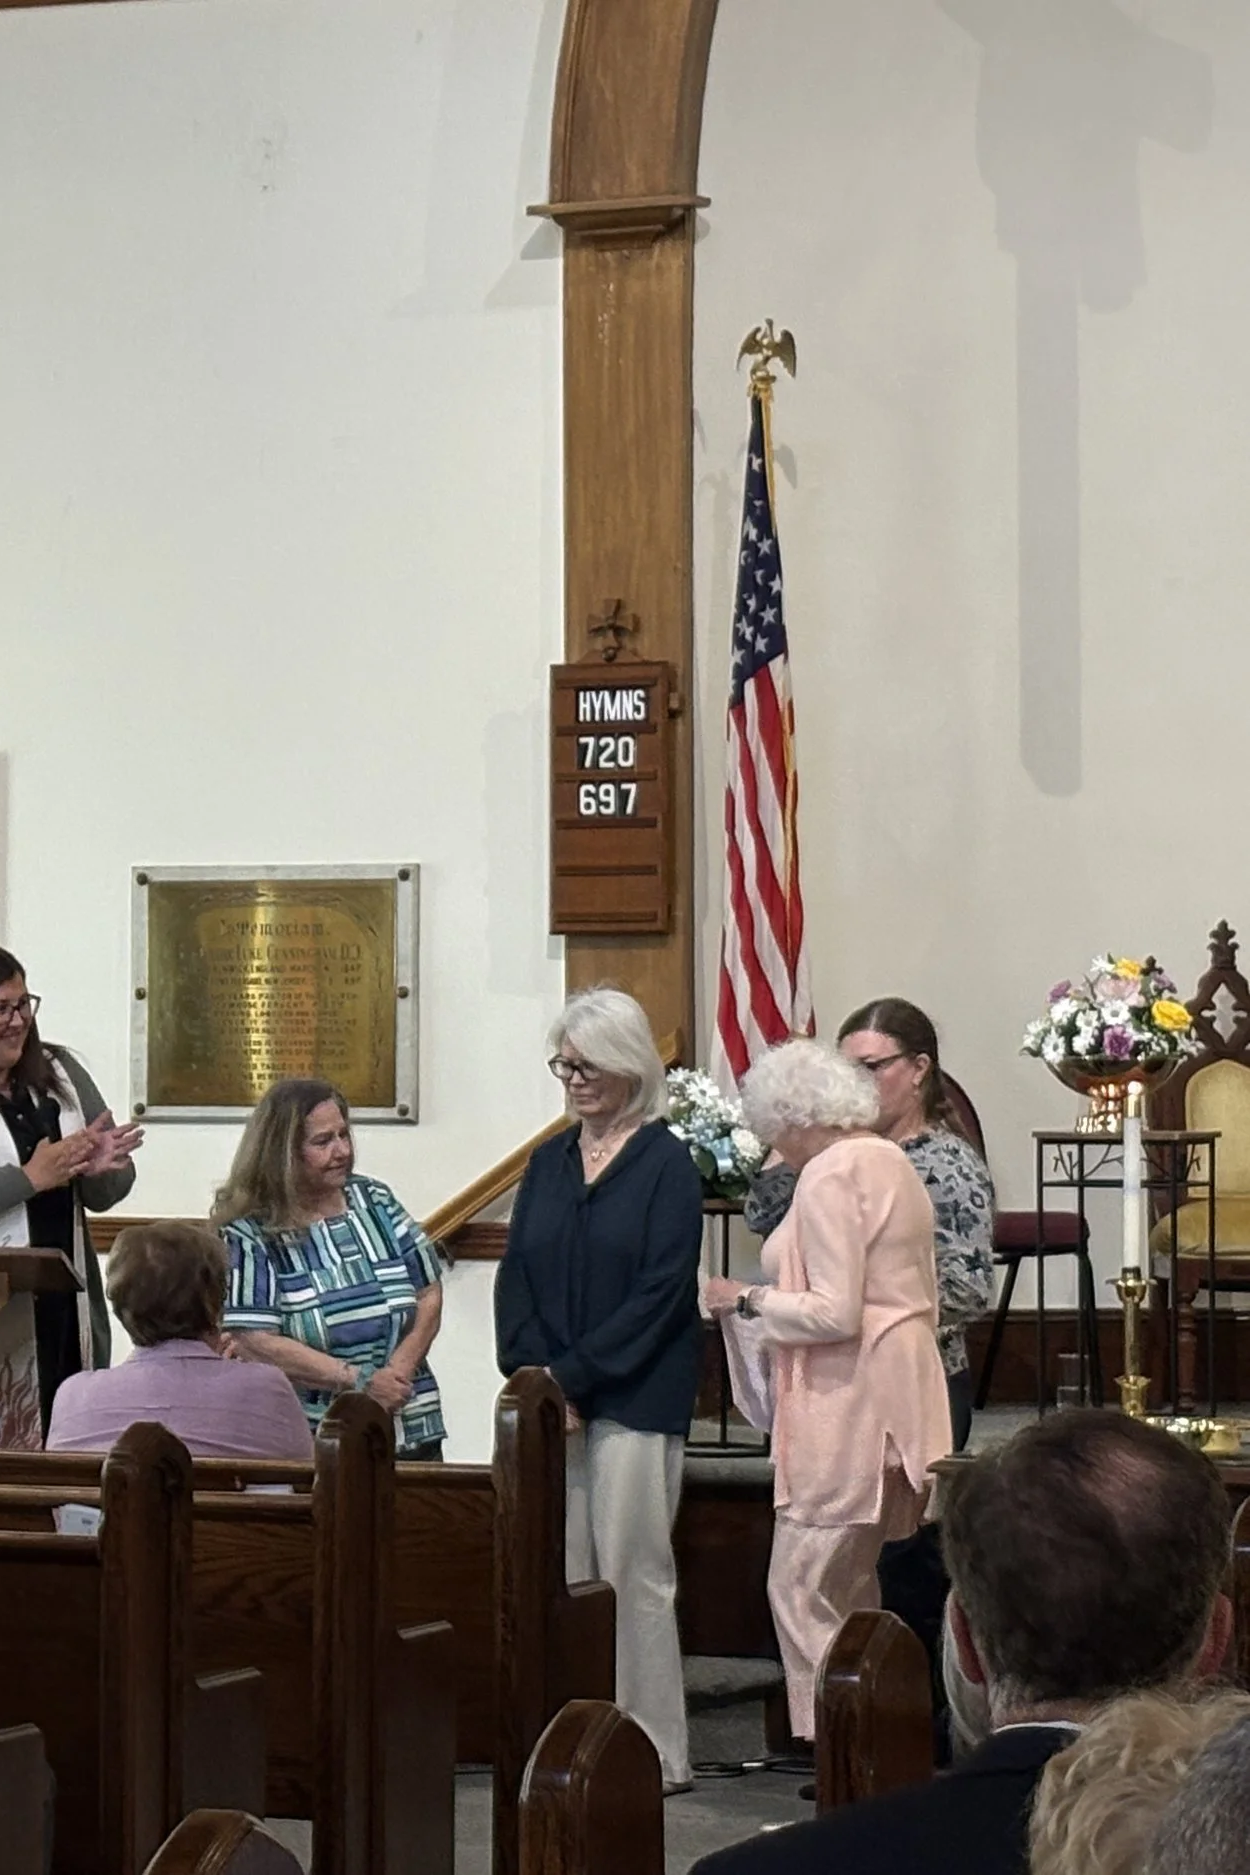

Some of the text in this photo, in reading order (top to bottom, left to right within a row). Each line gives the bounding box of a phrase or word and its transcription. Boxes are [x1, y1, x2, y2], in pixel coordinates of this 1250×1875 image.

[579, 689, 645, 722] HYMNS
[579, 736, 635, 768] 720
[579, 783, 637, 815] 697
